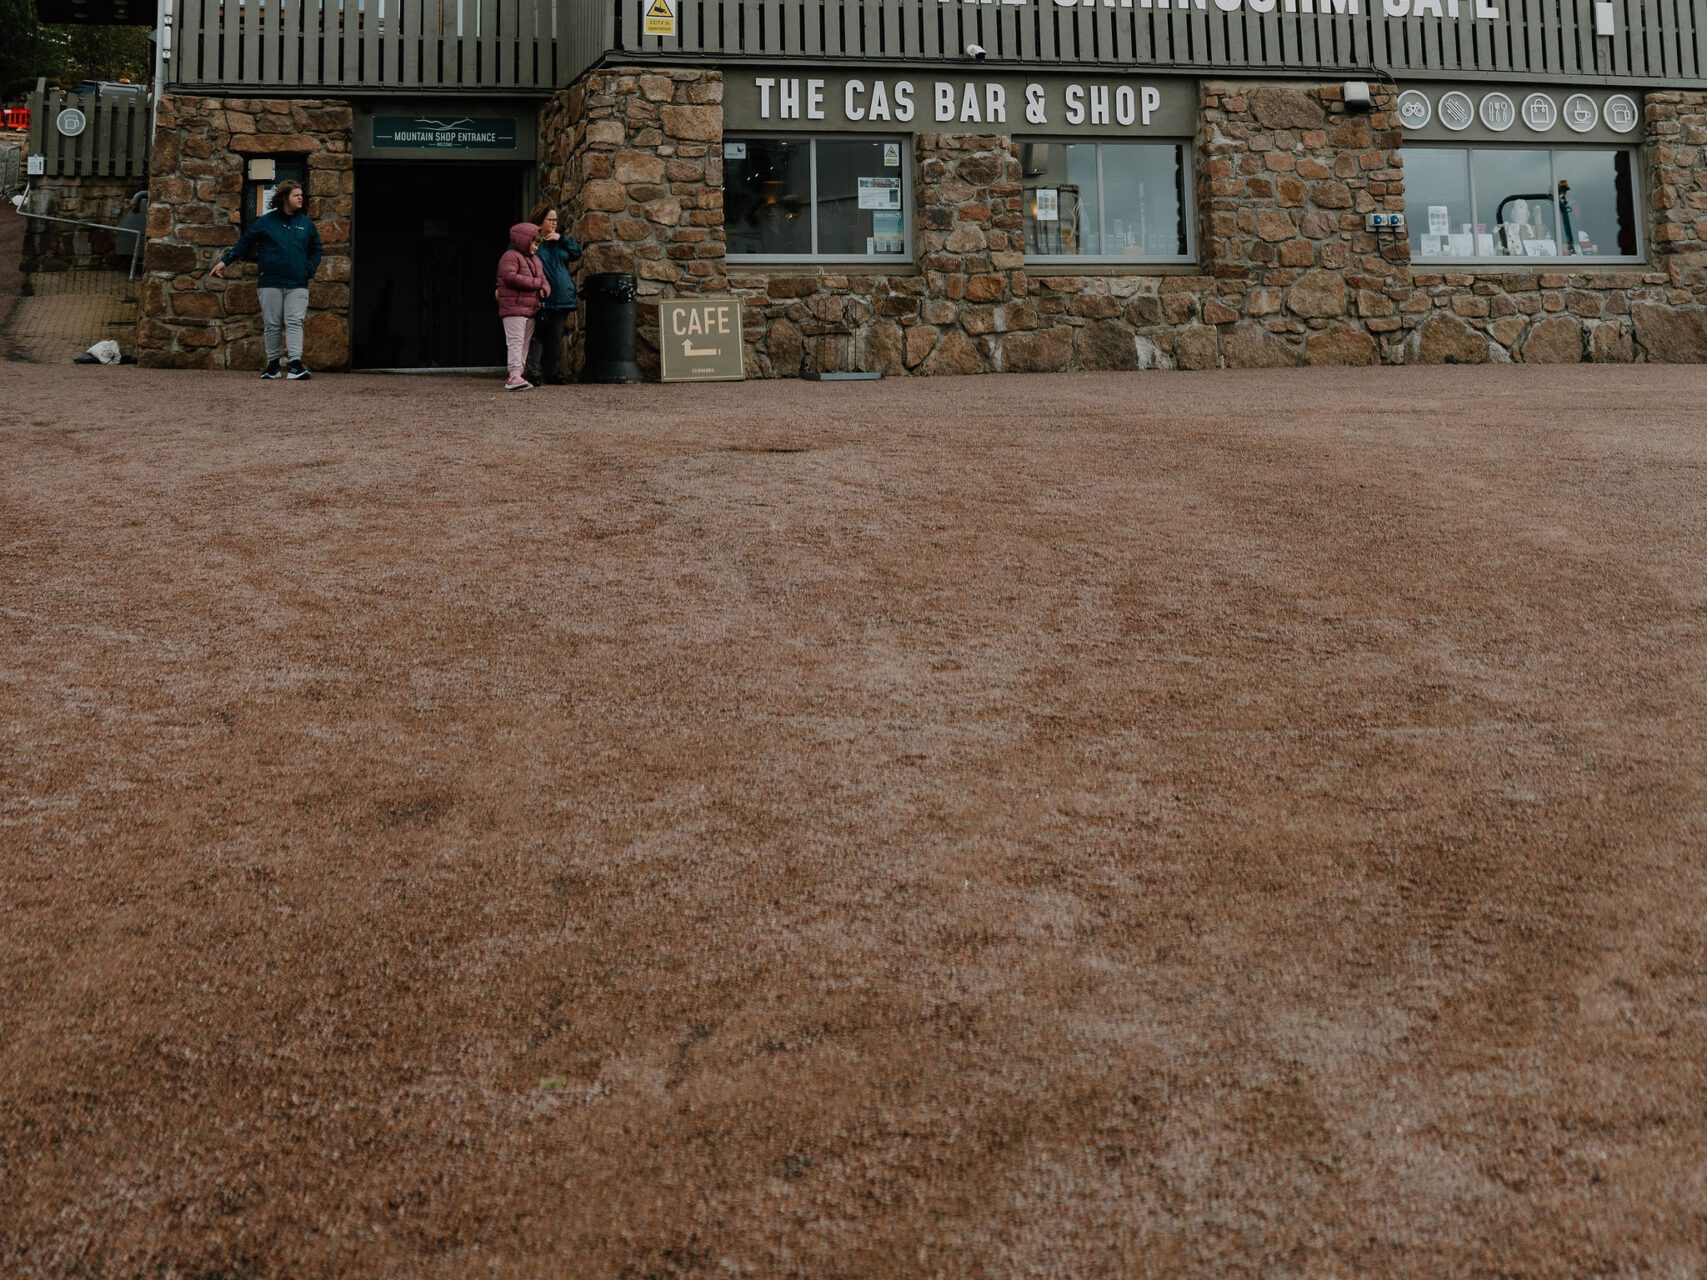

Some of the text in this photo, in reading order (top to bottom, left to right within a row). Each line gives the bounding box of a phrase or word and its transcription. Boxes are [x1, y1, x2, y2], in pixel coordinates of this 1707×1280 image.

[755, 77, 1161, 125] THE CAS BAR & SHOP
[394, 132, 496, 142] MOUNTAIN SHOP ENTRANCE
[672, 306, 730, 336] CAFE
